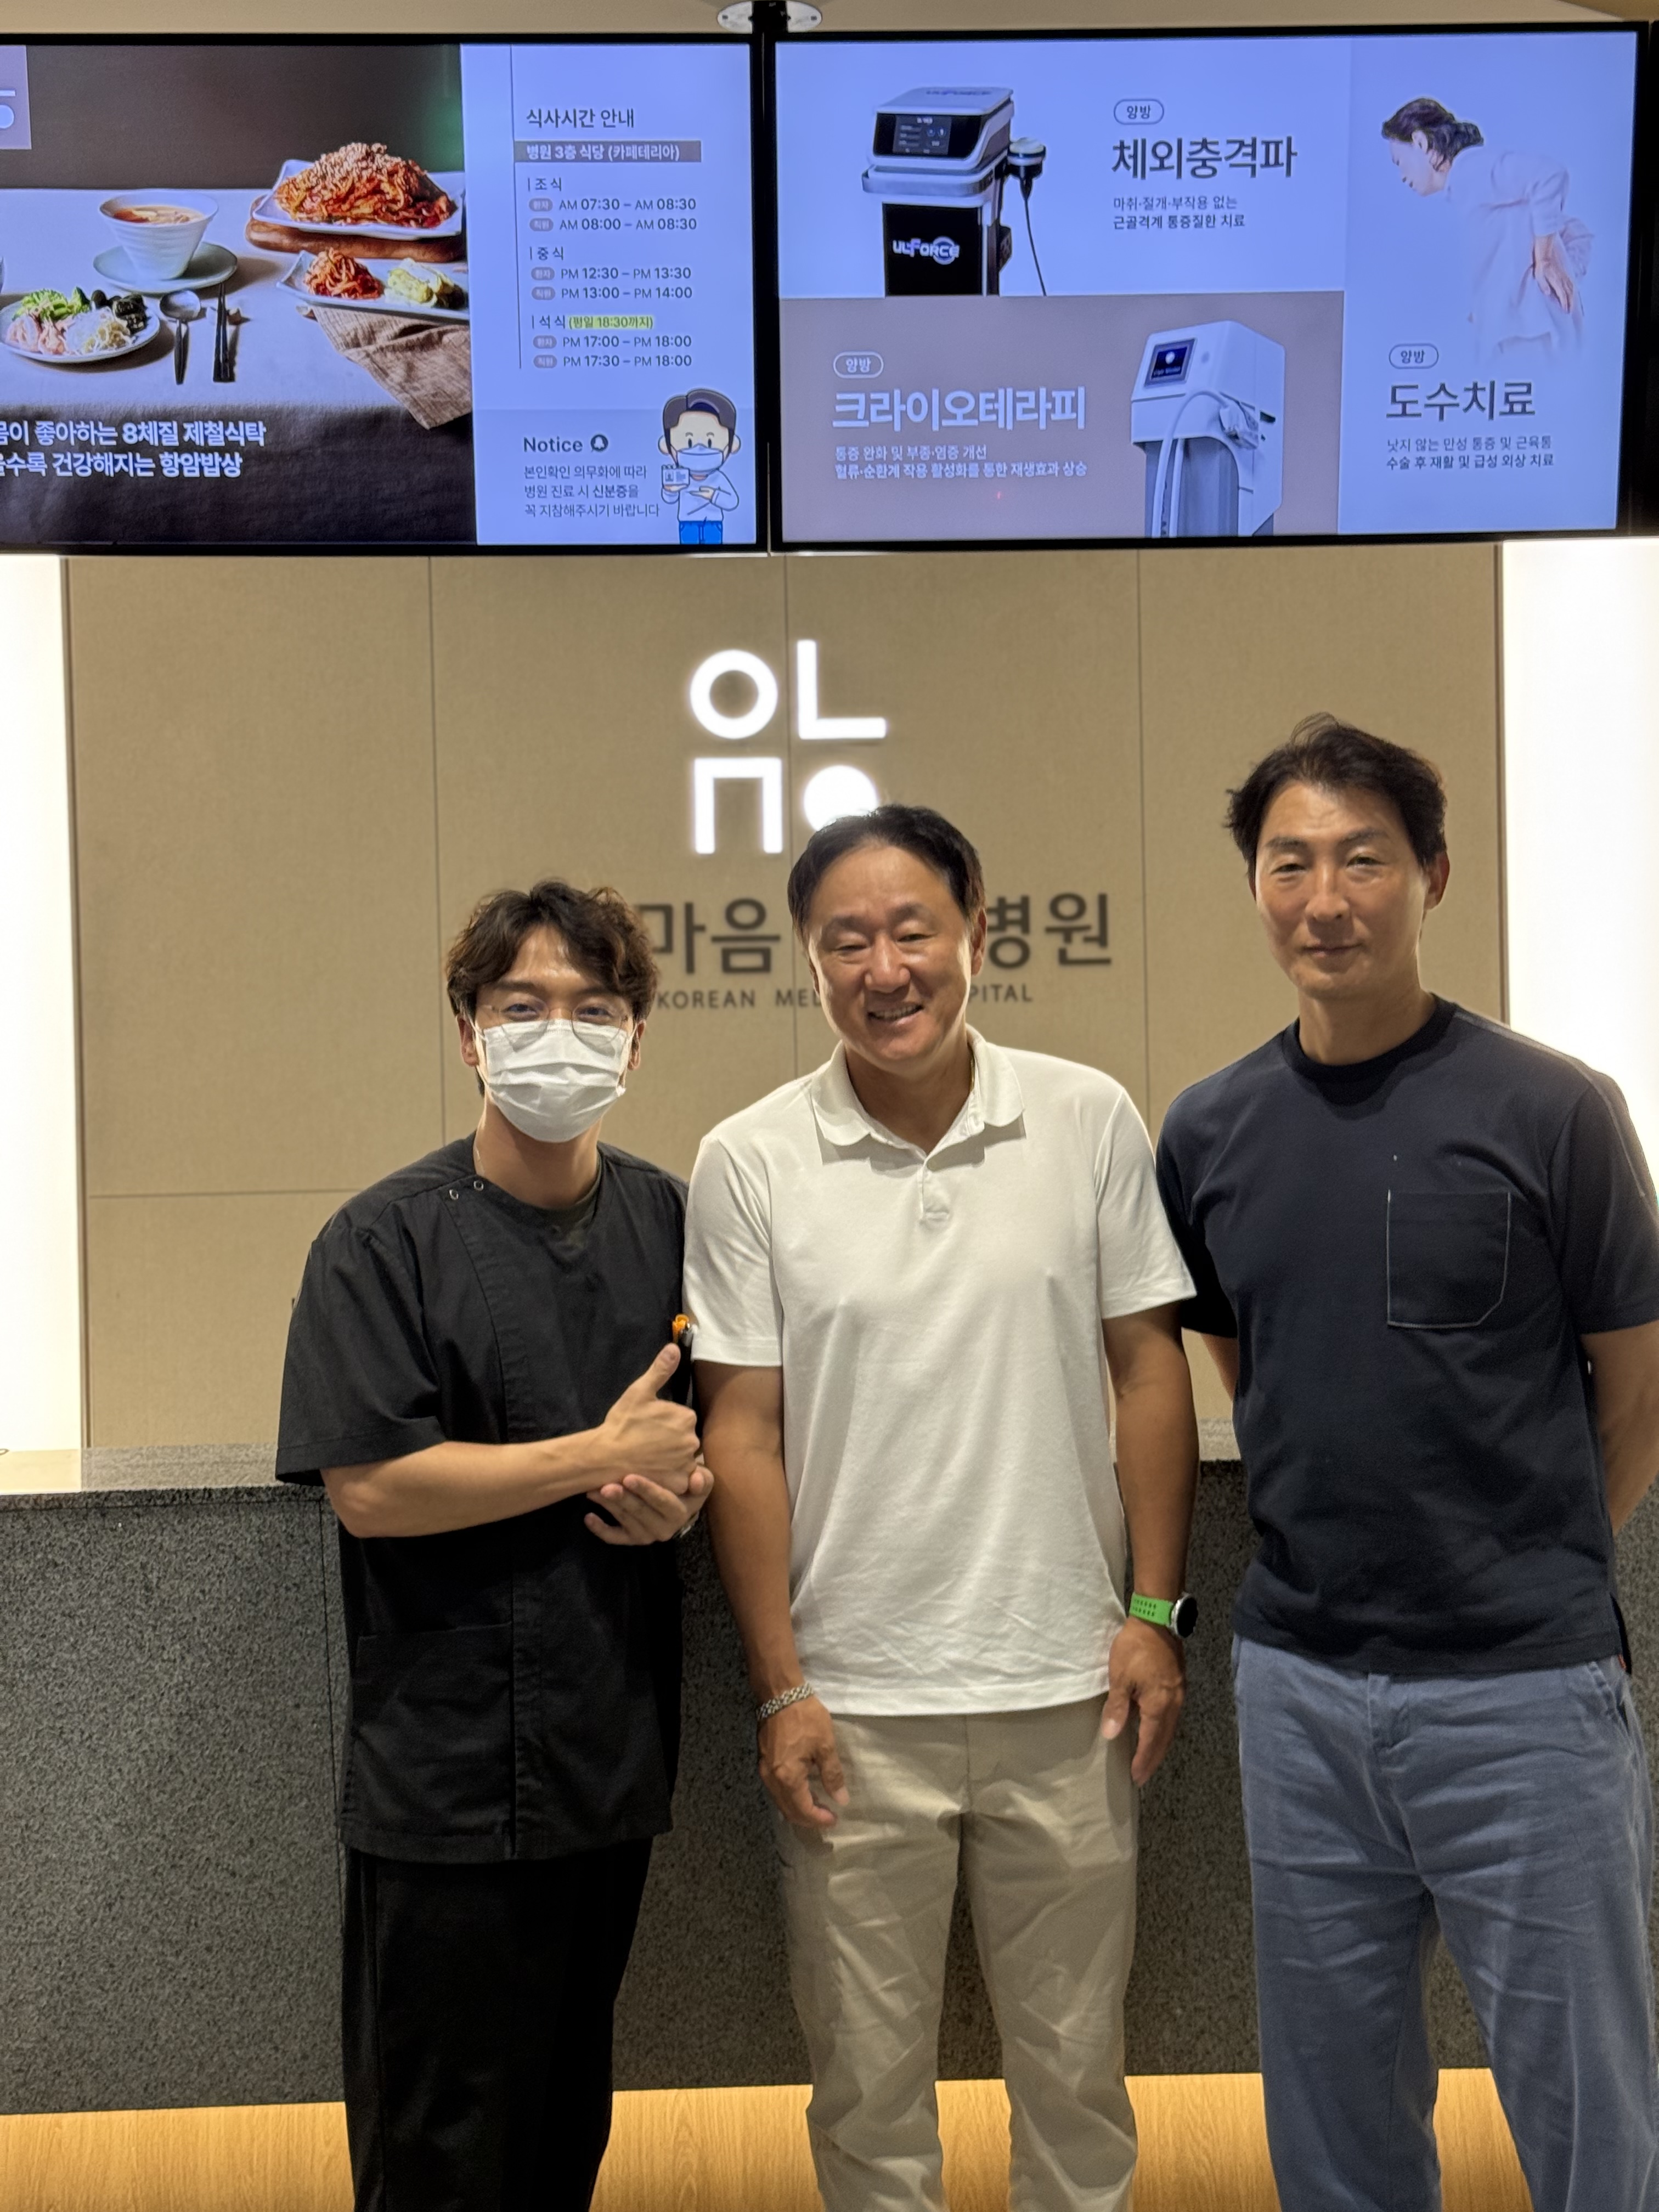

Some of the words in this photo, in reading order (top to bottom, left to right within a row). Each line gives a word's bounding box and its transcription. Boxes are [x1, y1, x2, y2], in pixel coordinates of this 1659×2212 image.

[526, 108, 596, 128] 식사시간
[600, 108, 634, 128] 안내
[1126, 105, 1151, 120] 양방
[526, 144, 552, 160] 병원
[555, 145, 576, 160] 3층
[579, 144, 605, 160] 식당
[608, 144, 680, 161] (카페테리아)
[1111, 136, 1298, 180] 체외충격파
[559, 199, 578, 211] AM
[580, 198, 620, 211] 07:30
[634, 199, 653, 211] AM
[657, 198, 697, 211] 08:30
[1213, 195, 1238, 211] 없는
[560, 219, 578, 230] AM
[581, 218, 622, 230] 08:00
[635, 219, 654, 230] AM
[657, 218, 697, 230] 08:30
[1113, 215, 1163, 230] 근골격계
[1221, 213, 1245, 228] 치료
[561, 268, 579, 279] PM
[582, 267, 619, 279] 12:30
[633, 268, 651, 279] PM
[654, 267, 692, 279] 13:30
[561, 288, 579, 299] PM
[583, 286, 620, 299] 13:00
[634, 288, 652, 299] PM
[656, 286, 692, 299] 14:00
[597, 315, 654, 330] 18:30까지)
[563, 336, 581, 347] PM
[584, 335, 620, 347] 17:00
[634, 336, 652, 347] PM
[655, 335, 692, 347] 18:00
[563, 356, 582, 367] PM
[585, 354, 620, 367] 17:30
[634, 356, 652, 367] PM
[655, 354, 692, 367] 18:00
[1400, 349, 1425, 364] 양방
[845, 357, 872, 373] 양방
[832, 386, 1085, 432] 크라이오테라피
[1386, 380, 1536, 422] 도수치료
[35, 420, 119, 446] 좋아하는
[122, 420, 179, 447] 8체질
[183, 420, 267, 447] 제철식탁
[523, 436, 583, 453] Notice
[863, 445, 887, 461] 완화
[891, 444, 904, 461] 및
[962, 443, 987, 460] 개선
[1386, 437, 1411, 453] 낫지
[1415, 437, 1440, 452] 않는
[1443, 437, 1468, 452] 만성
[1500, 436, 1511, 451] 및
[0, 451, 48, 477] 수록
[52, 451, 156, 477] 건강해지는
[160, 451, 242, 478] 항암밥상
[903, 462, 928, 479] 작용
[1011, 460, 1060, 478] 재생효과
[1062, 460, 1088, 478] 상승
[1386, 456, 1410, 471] 수술
[1414, 455, 1427, 470] 후
[1430, 455, 1454, 470] 재활
[1458, 454, 1470, 470] 및
[1474, 454, 1498, 469] 급성
[1502, 453, 1526, 469] 외상
[1530, 453, 1554, 467] 치료
[524, 465, 571, 479] 본인확인
[574, 465, 621, 479] 의무화에
[624, 465, 647, 479] 따라
[524, 484, 548, 499] 병원
[551, 484, 574, 499] 진료
[578, 484, 589, 499] 시
[592, 483, 639, 499] 신분증을
[524, 504, 536, 518] 꼭
[539, 503, 610, 518] 지참해주시기
[613, 503, 660, 518] 바랍니다
[659, 989, 756, 1009] KOREAN
[969, 983, 1032, 1003] PITAL
